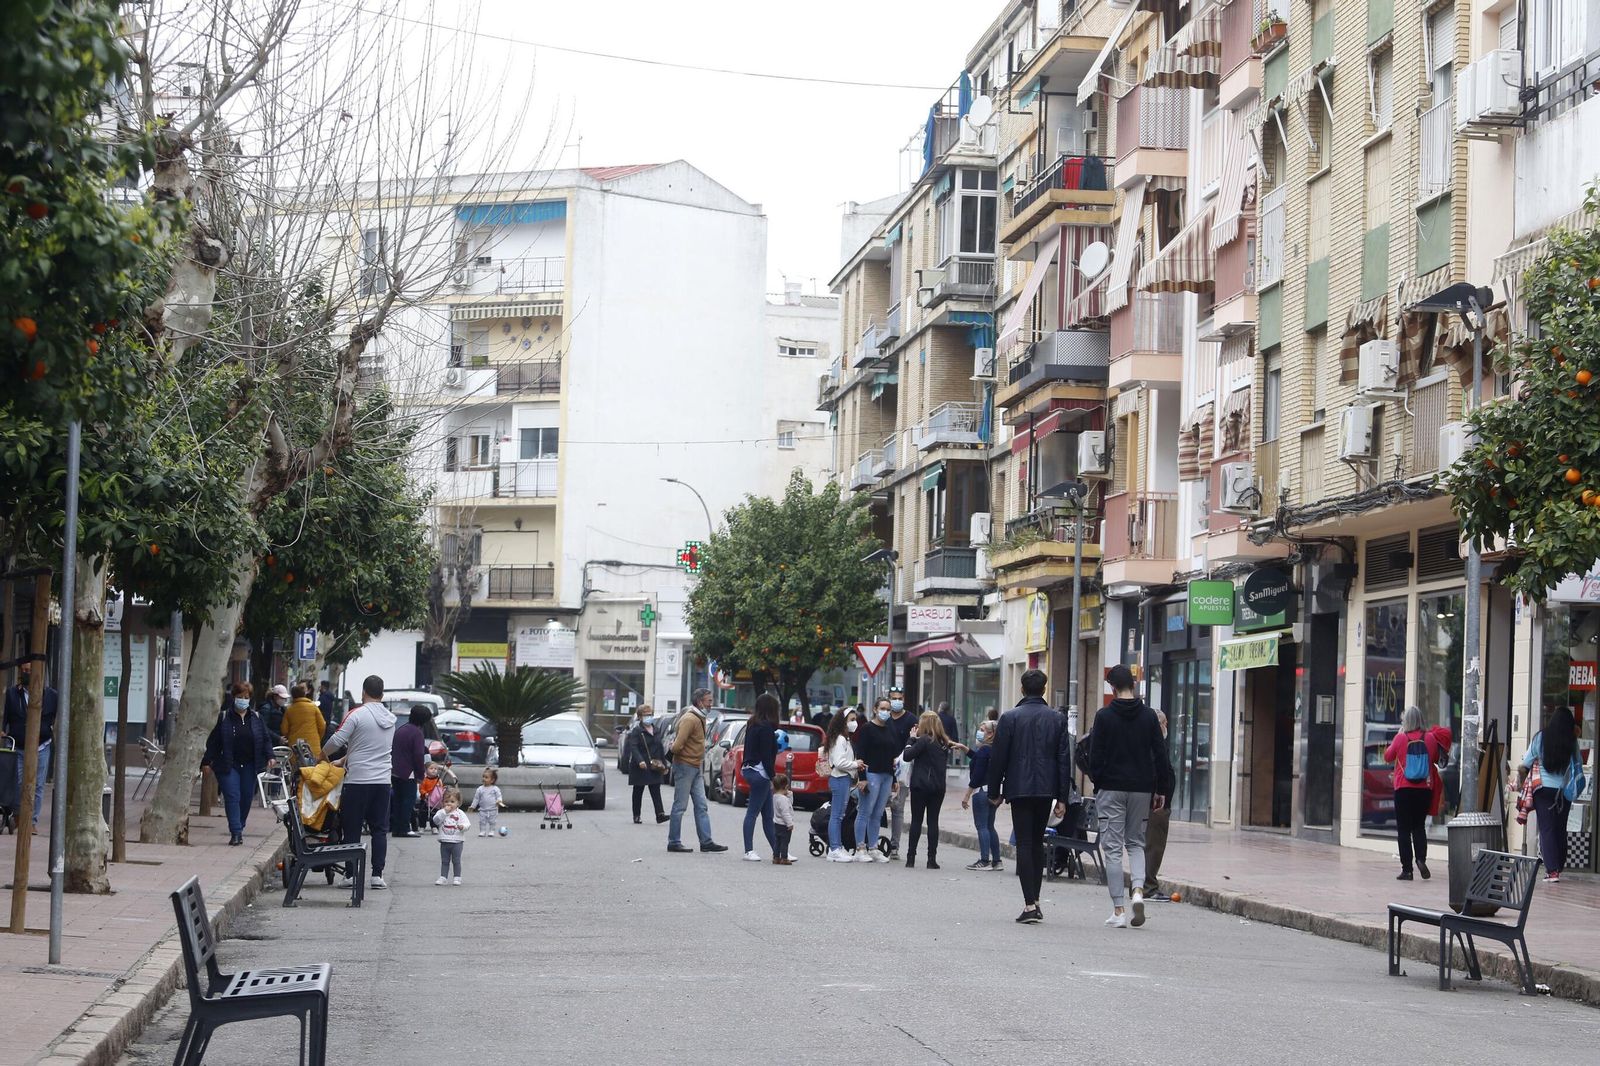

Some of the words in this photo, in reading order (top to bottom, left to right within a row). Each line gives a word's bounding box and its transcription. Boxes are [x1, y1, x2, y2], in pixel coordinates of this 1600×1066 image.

[1192, 595, 1230, 605] codere
[303, 633, 313, 656] P
[613, 645, 649, 654] marrubial
